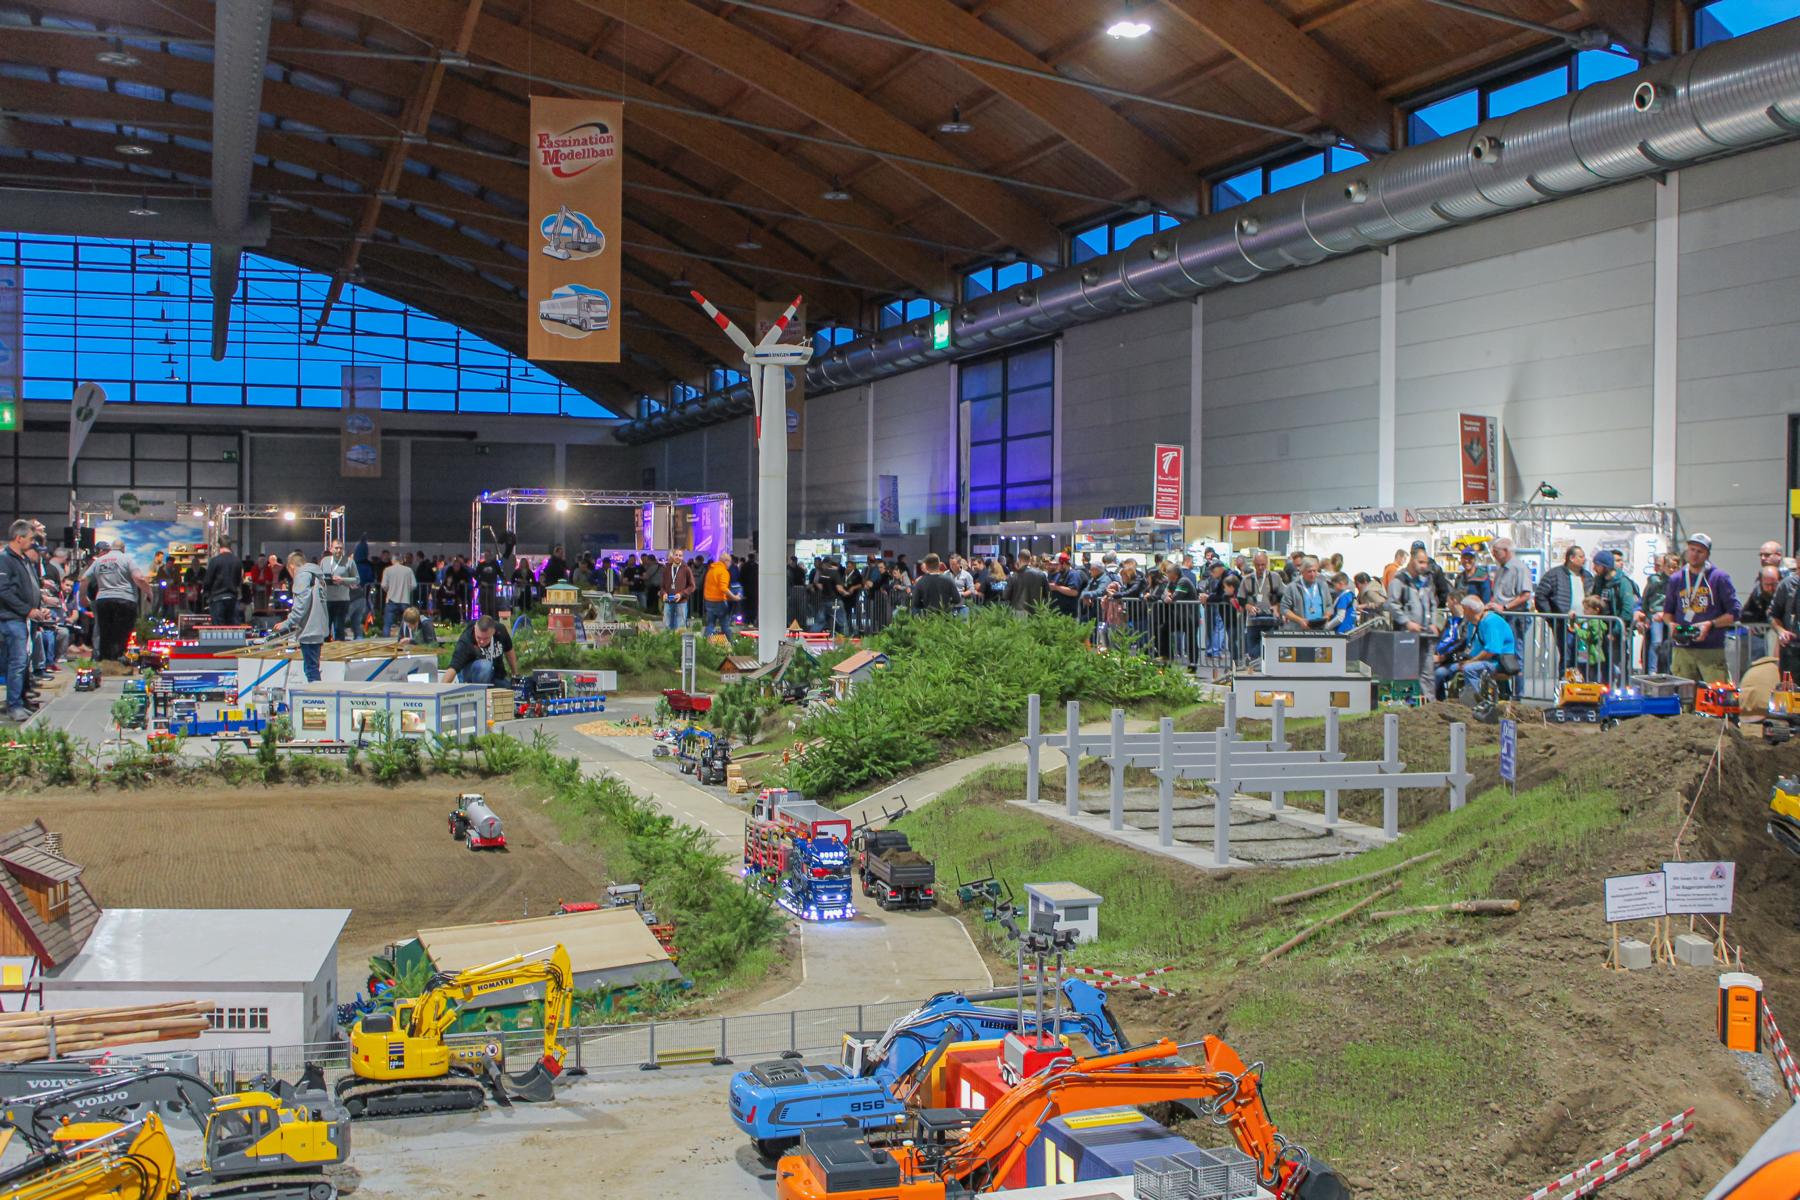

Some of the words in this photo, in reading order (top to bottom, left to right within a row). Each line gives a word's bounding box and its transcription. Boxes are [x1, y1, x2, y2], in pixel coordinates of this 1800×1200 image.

[537, 133, 614, 149] Faszination
[542, 148, 614, 165] Modellbau
[477, 977, 515, 992] KOMATSU
[73, 1091, 129, 1109] VOLVO
[851, 1100, 885, 1112] 956
